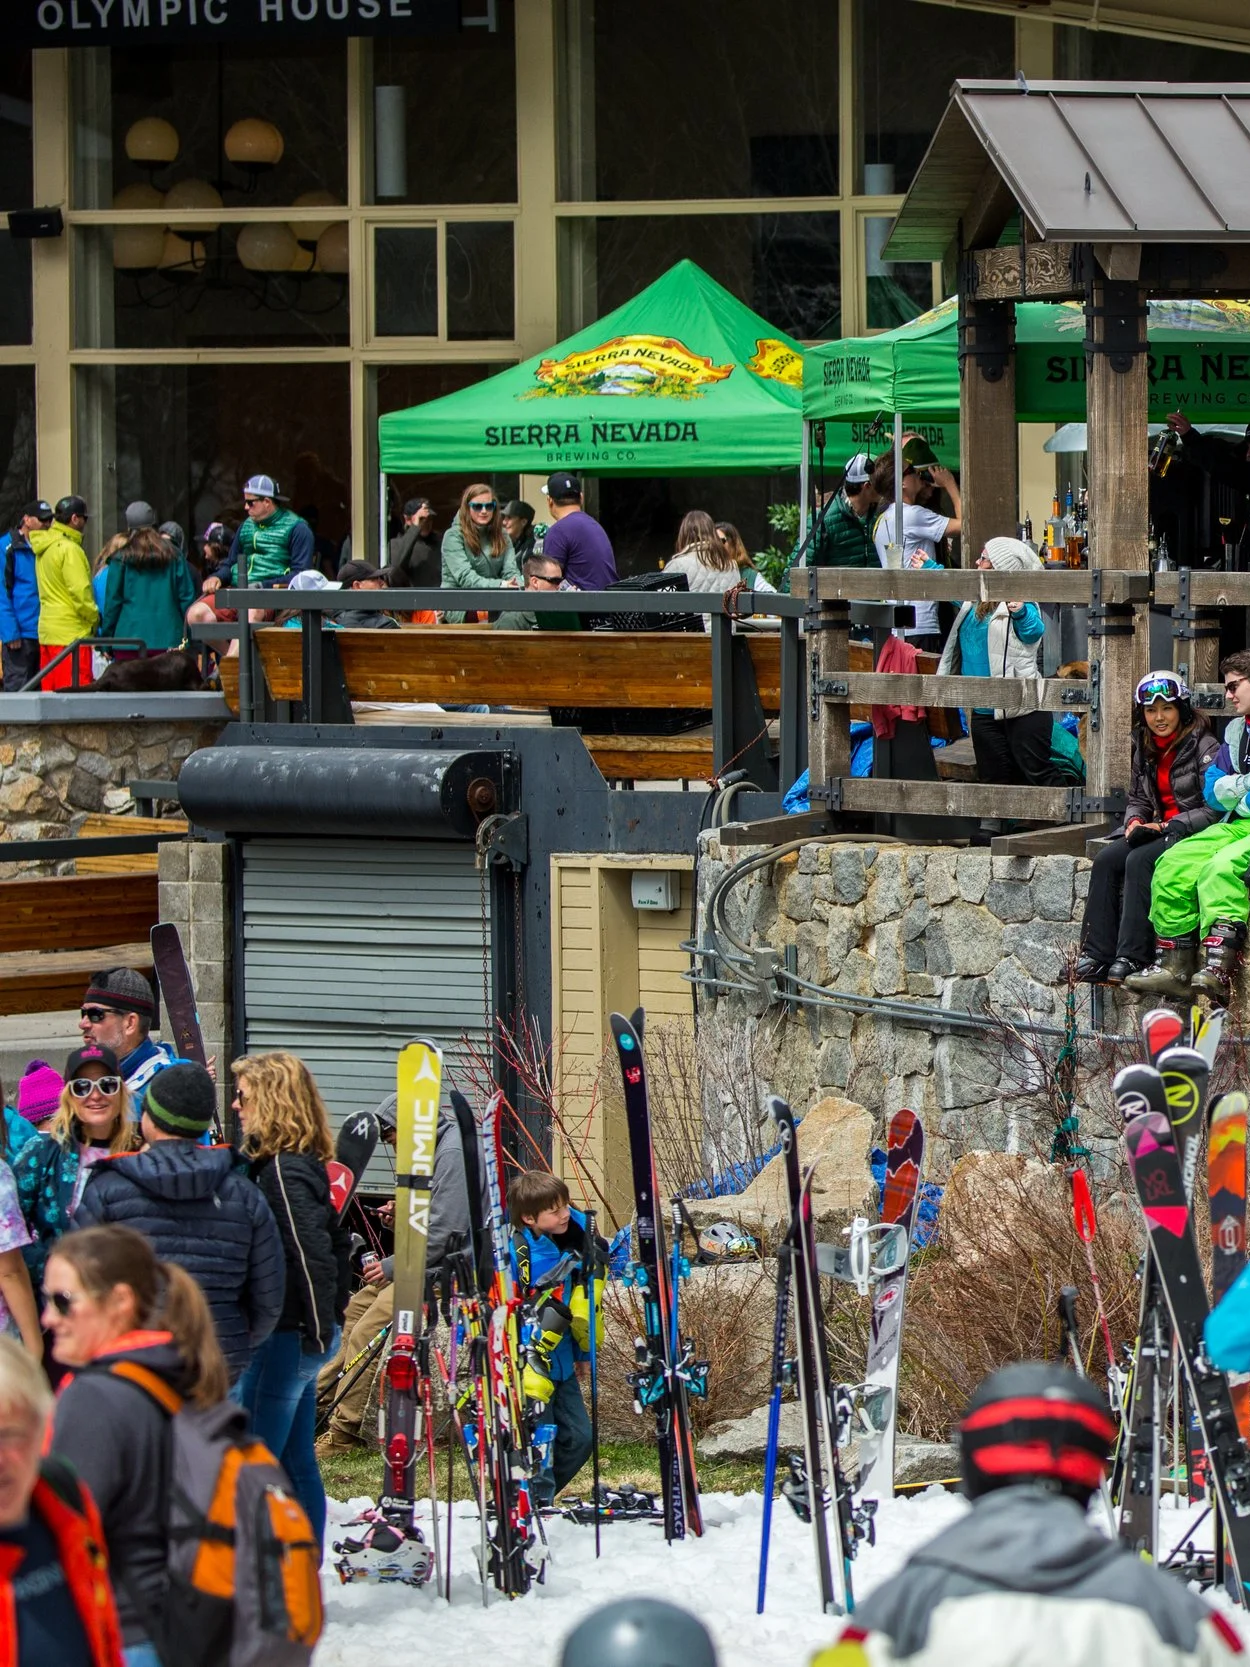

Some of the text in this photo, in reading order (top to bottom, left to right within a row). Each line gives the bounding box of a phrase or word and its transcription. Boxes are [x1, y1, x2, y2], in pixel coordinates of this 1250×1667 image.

[37, 0, 412, 30] OLYMPIC HOUSE
[565, 348, 699, 374] SIERRA NEVADA
[1046, 354, 1186, 386] SIRA
[1150, 393, 1226, 404] REWING
[484, 421, 699, 448] SIERRA NEVADA
[546, 451, 636, 462] BREWING CO.
[1183, 1133, 1200, 1205] SIGNOL
